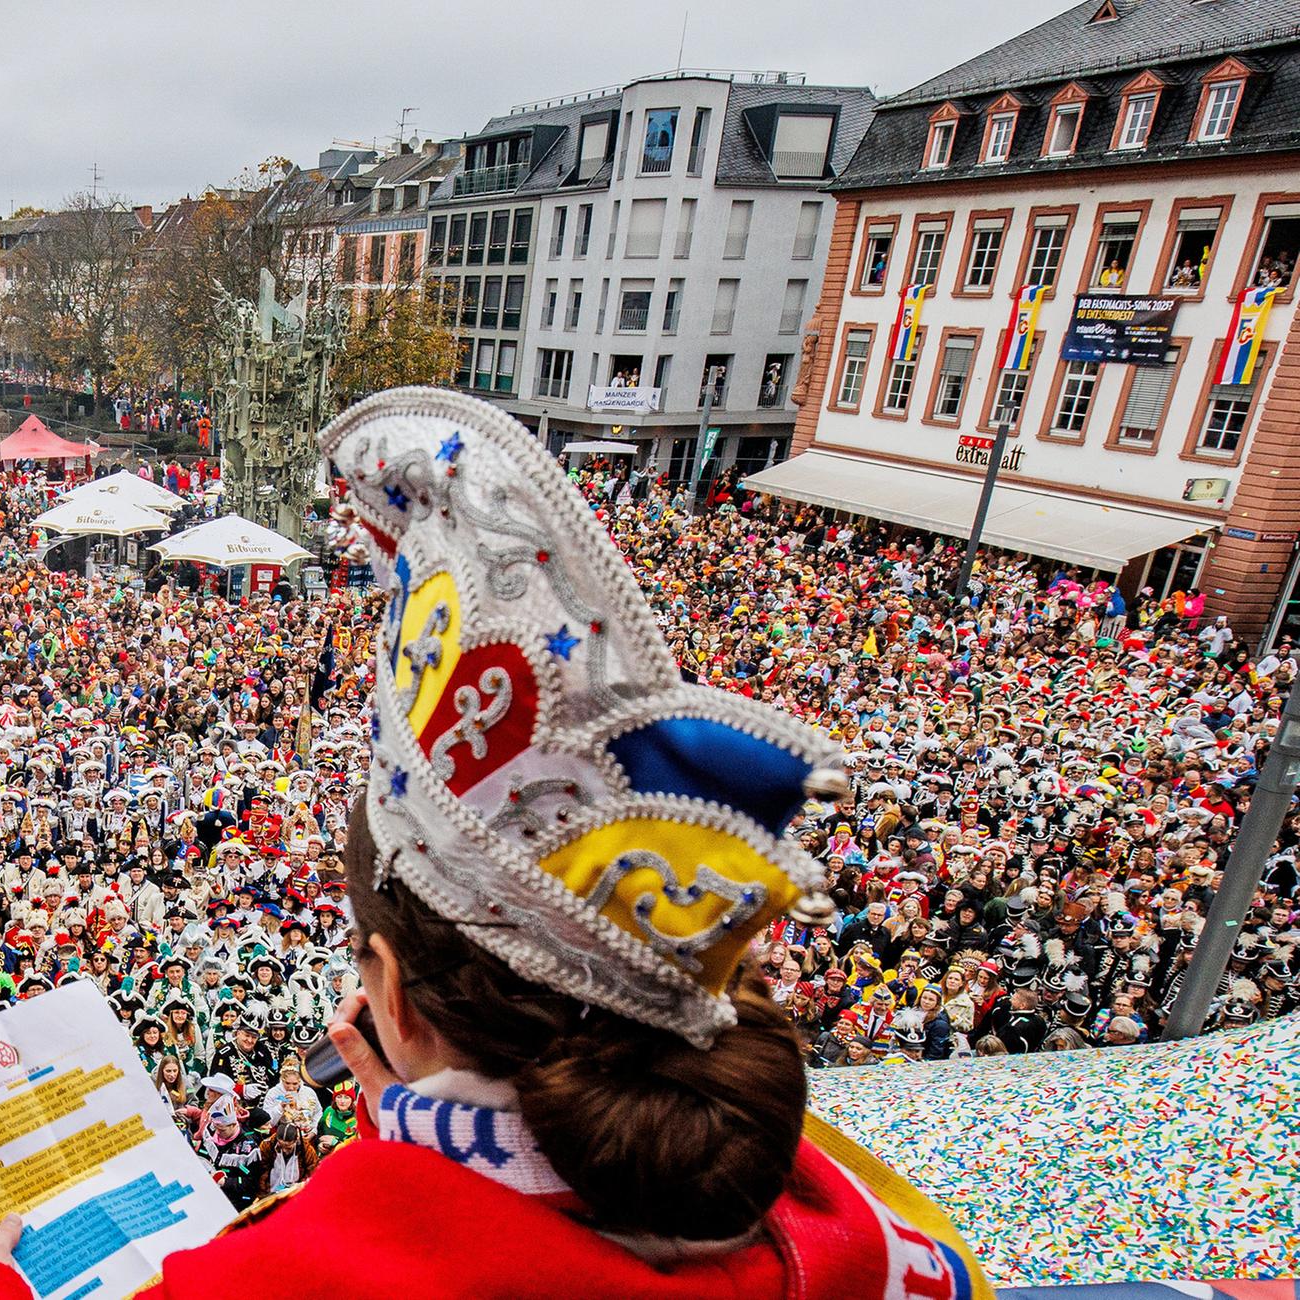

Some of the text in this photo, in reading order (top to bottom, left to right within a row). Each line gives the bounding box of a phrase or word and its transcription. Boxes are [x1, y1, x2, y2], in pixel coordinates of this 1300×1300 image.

[1078, 299, 1092, 308] DER
[1076, 310, 1086, 319] DU
[226, 543, 273, 554] Bitburger
